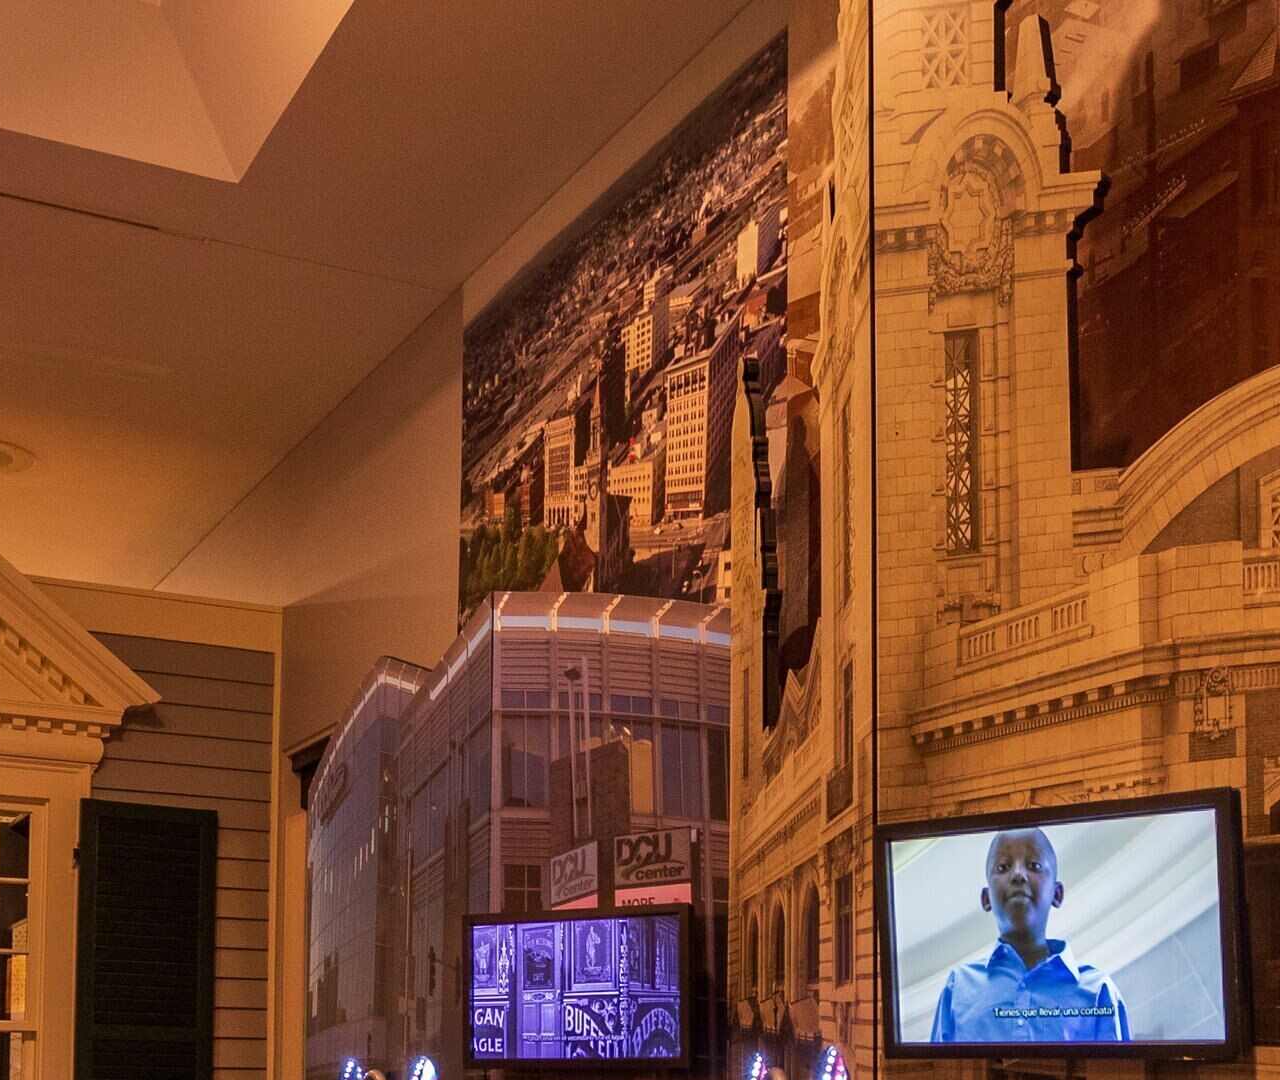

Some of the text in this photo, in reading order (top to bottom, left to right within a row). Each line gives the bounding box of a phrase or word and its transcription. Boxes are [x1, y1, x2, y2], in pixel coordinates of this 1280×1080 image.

[616, 832, 673, 867] DCU
[552, 848, 587, 886] DCU
[635, 864, 685, 881] center
[563, 879, 595, 897] center
[1021, 1008, 1038, 1019] que
[1039, 1007, 1061, 1017] llevar
[1063, 1008, 1078, 1016] una
